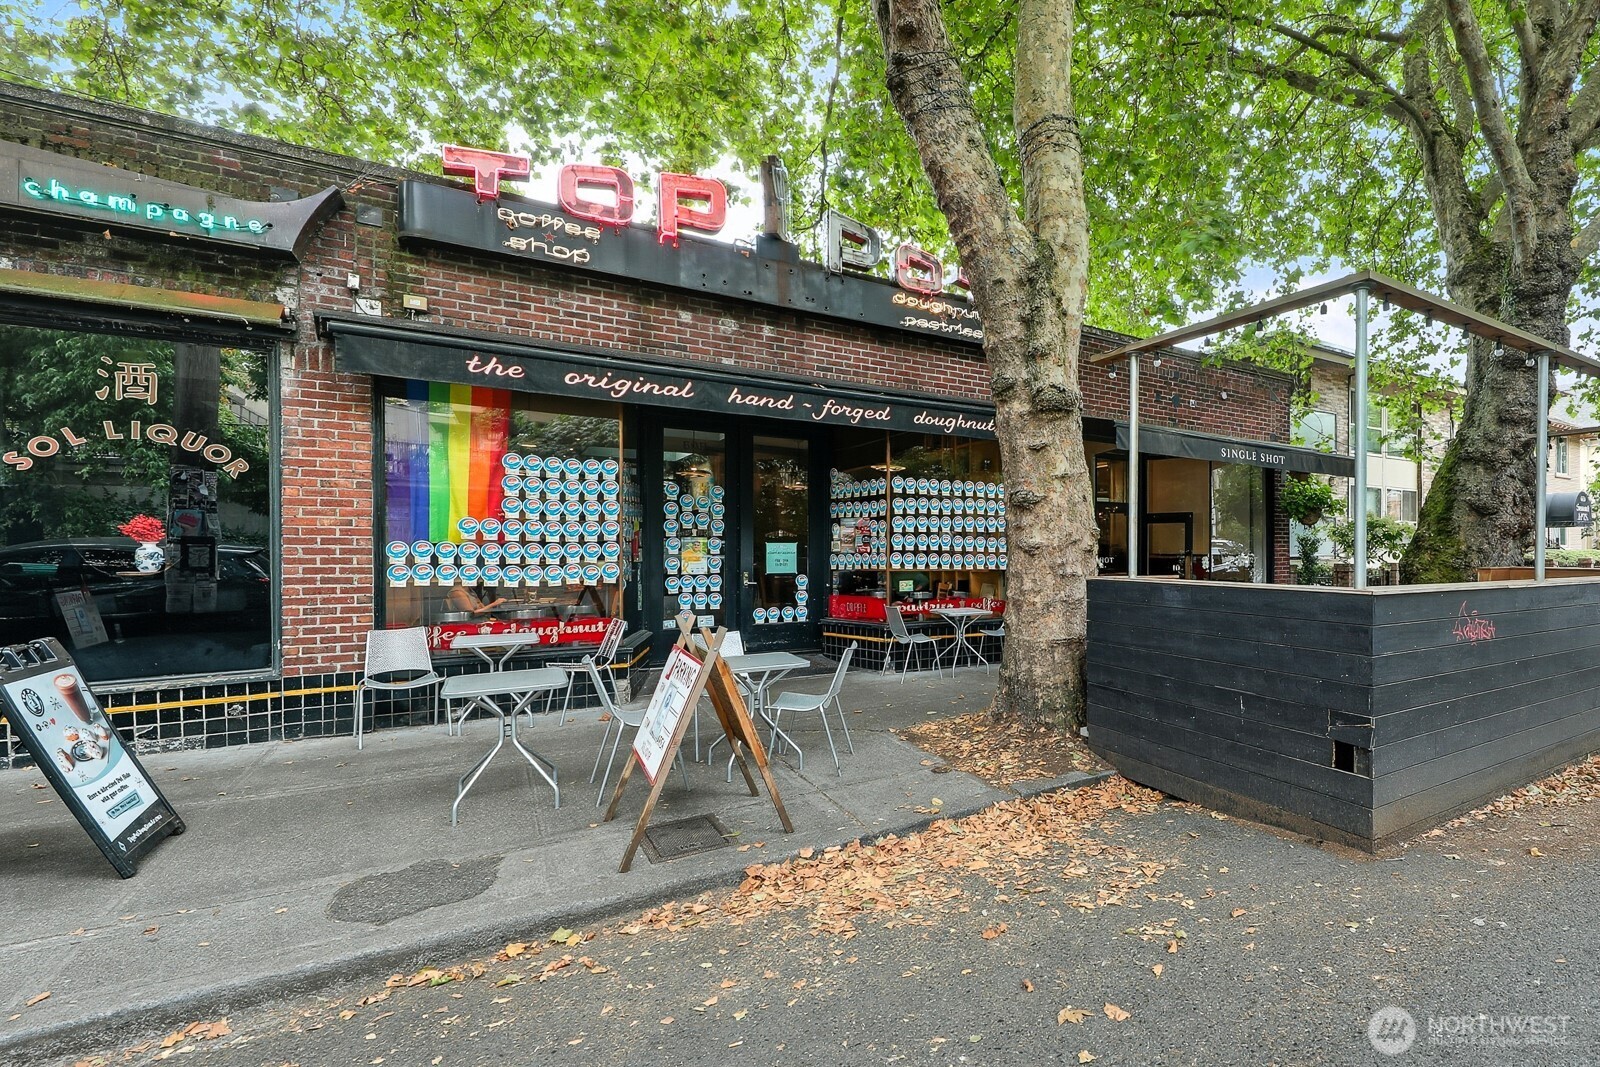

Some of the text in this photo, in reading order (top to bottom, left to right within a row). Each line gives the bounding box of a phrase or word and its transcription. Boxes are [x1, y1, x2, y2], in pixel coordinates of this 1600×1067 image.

[23, 178, 264, 233] champagne
[441, 143, 728, 248] TOP
[497, 206, 602, 246] coffee
[502, 236, 591, 264] shop
[95, 355, 159, 406] 酒
[465, 355, 525, 379] the
[564, 372, 695, 399] original
[727, 387, 794, 410] hand
[811, 399, 891, 424] forged
[913, 411, 998, 434] doughnut
[2, 419, 250, 480] SOL LIQUOR
[1221, 447, 1286, 465] SINGLE SHOT
